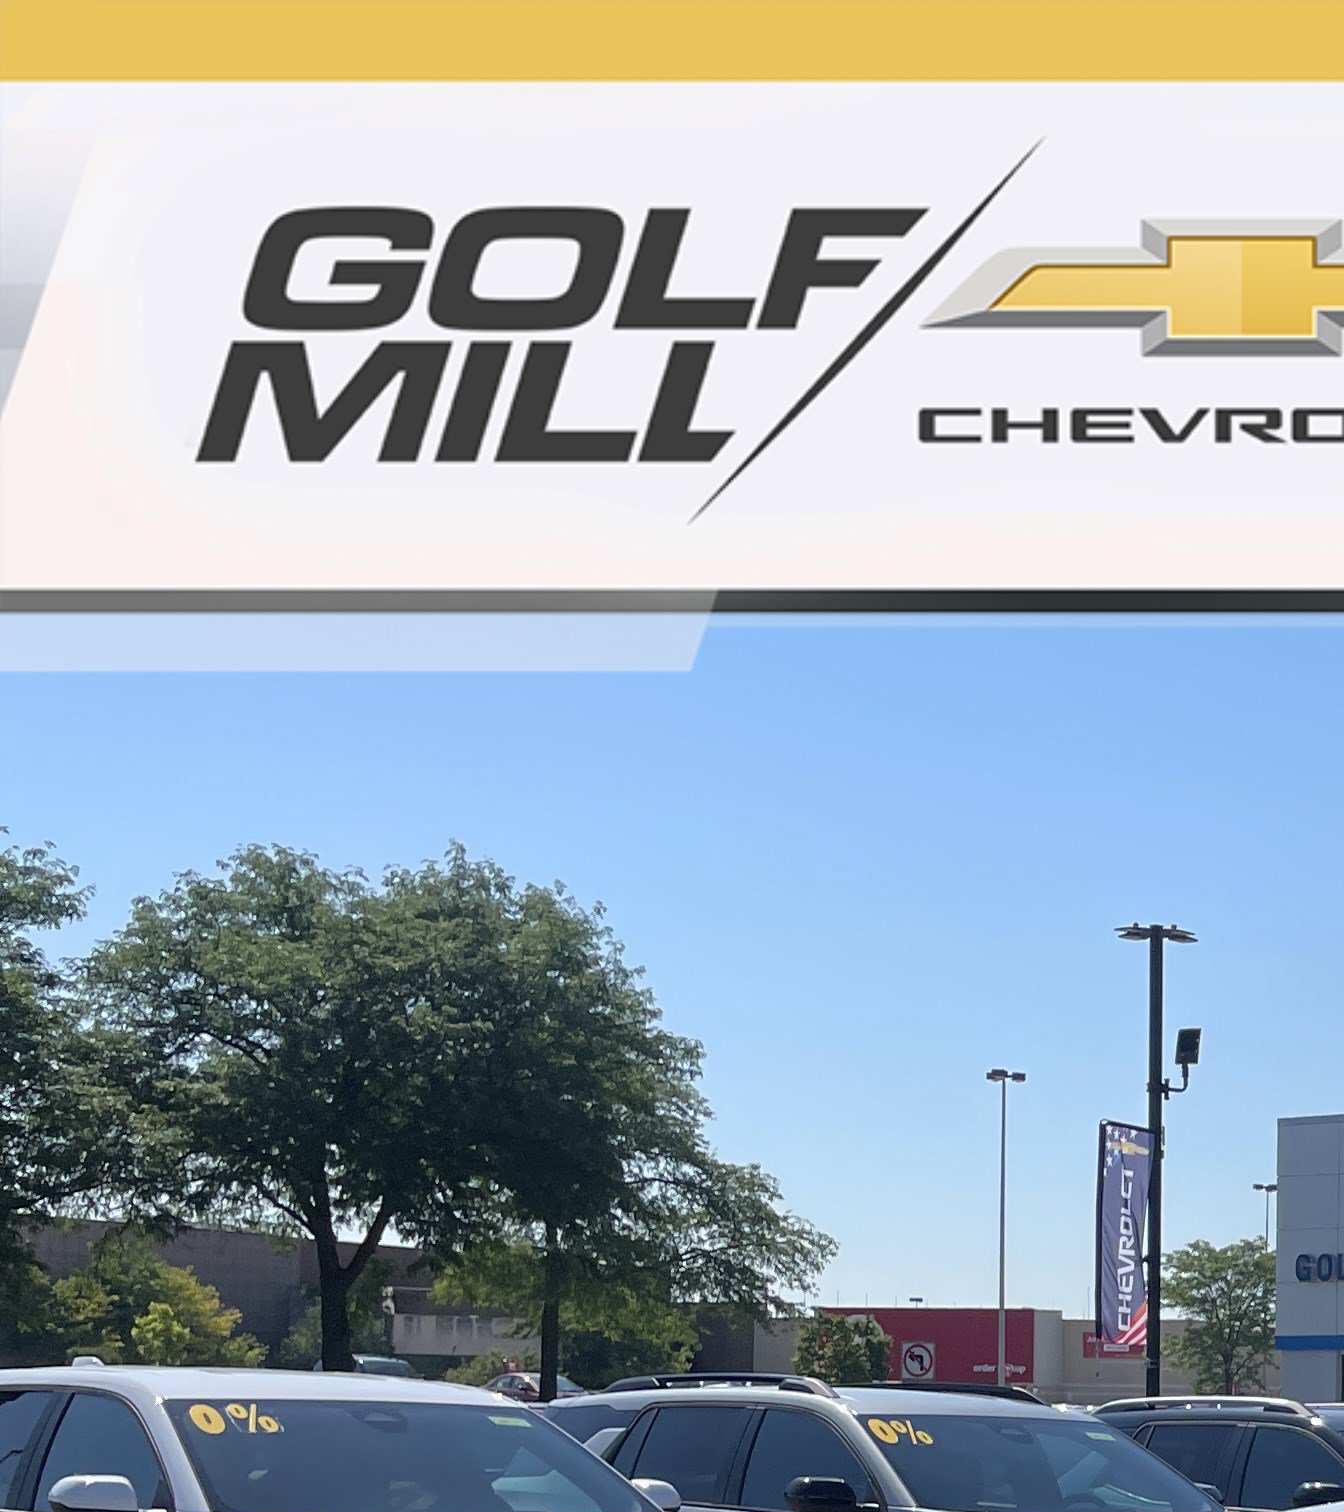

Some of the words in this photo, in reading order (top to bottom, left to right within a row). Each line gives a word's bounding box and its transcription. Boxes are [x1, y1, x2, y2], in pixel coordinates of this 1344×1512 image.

[1117, 1168, 1135, 1332] CHEVROLET
[188, 1403, 280, 1434] 0%
[868, 1418, 934, 1445] 0%
